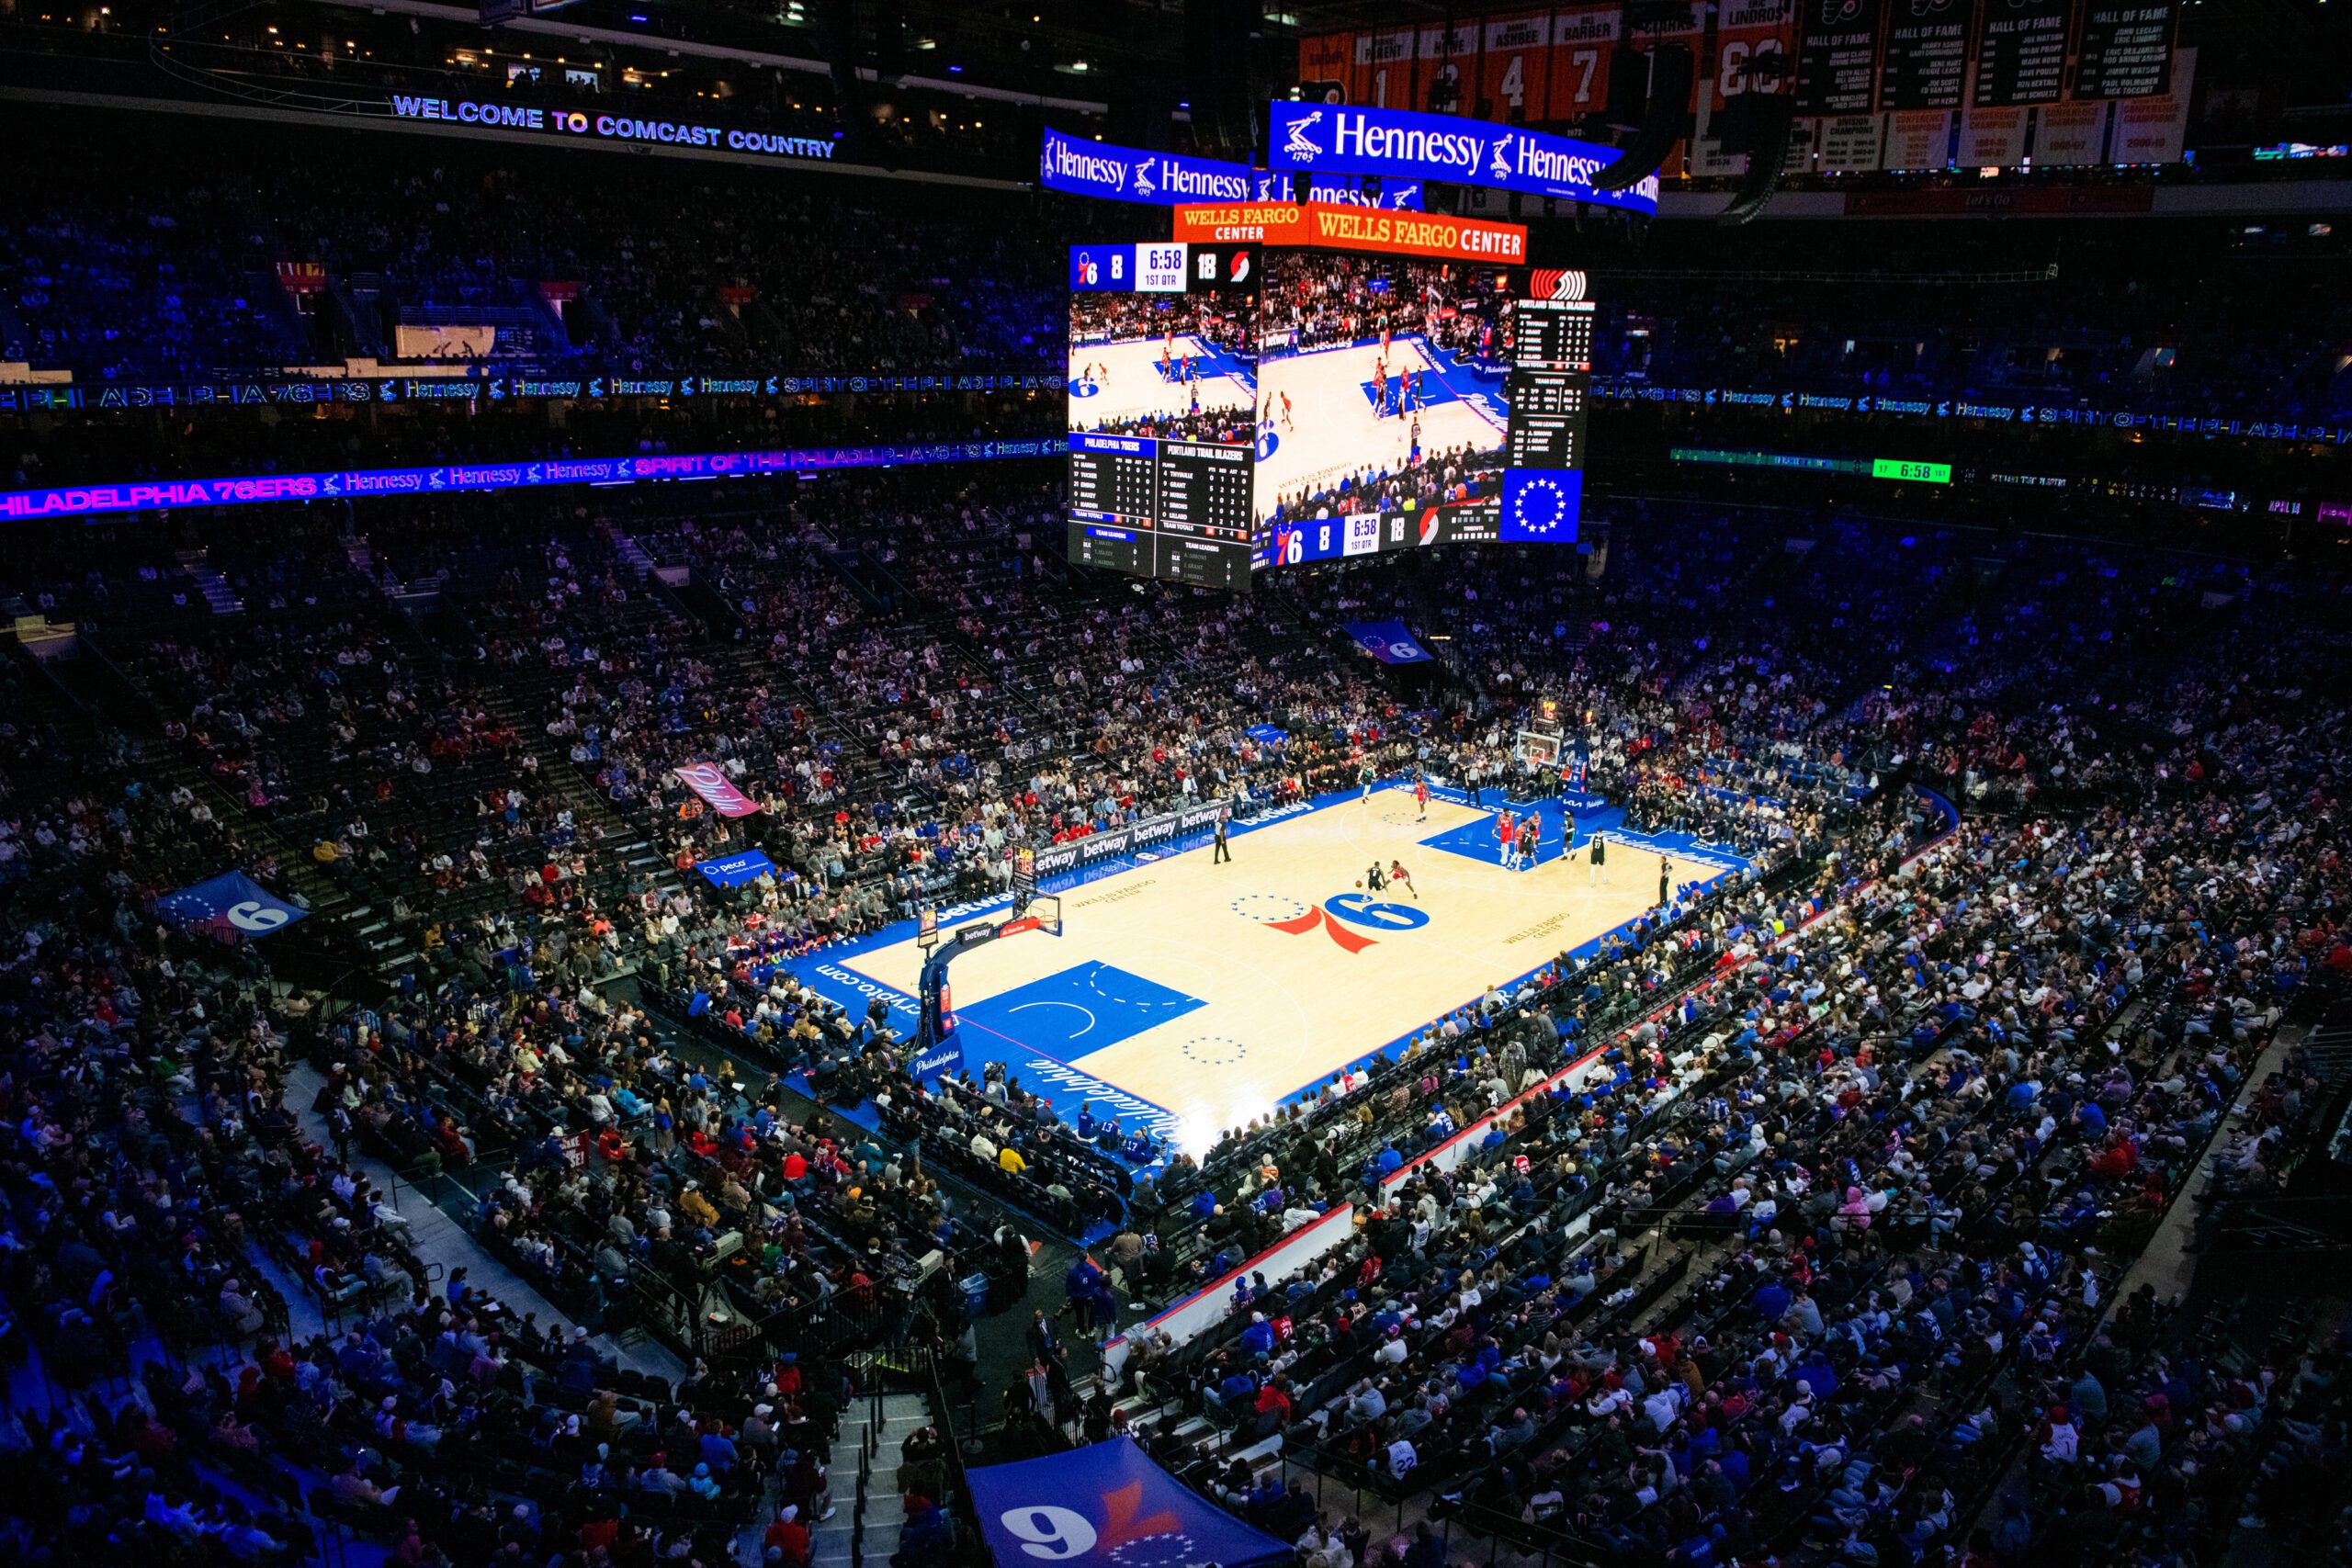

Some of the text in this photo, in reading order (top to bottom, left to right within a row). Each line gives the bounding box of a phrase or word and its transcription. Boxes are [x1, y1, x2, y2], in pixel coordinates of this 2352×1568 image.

[1728, 8, 1783, 25] LINDROS
[2093, 6, 2169, 23] HALL OF FAME
[1565, 24, 1611, 40] BARBER
[1894, 24, 1963, 39] HALL OF FAME
[1989, 16, 2063, 34] HALL OF FAME
[1496, 30, 1538, 47] ASHBEE
[1806, 32, 1871, 47] HALL OF FAME
[1500, 55, 1525, 107] 4
[1573, 49, 1599, 104] 7
[1969, 110, 2022, 121] CONFERENCE
[393, 96, 834, 158] WELCOME TO COMCAST COUNTRY
[1829, 126, 1874, 136] CHAMPIONS
[1291, 151, 1315, 163] 1765
[1335, 113, 1485, 176] Hennessy
[1057, 140, 1250, 203] Hennessy Hennessy
[1965, 194, 2011, 206] Let's Go
[1184, 208, 1299, 226] WELLS FARGO
[1215, 226, 1264, 240] CENTER
[1317, 211, 1522, 256] WELLS FARGO CENTER
[1111, 254, 1124, 279] 8
[1149, 249, 1182, 270] 6:58
[1197, 253, 1216, 279] 18
[1146, 274, 1177, 286] 1ST QTR
[1519, 299, 1547, 309] PORTLAND
[1548, 301, 1565, 310] TRAIL
[405, 379, 481, 400] Hennessy
[512, 378, 582, 398] Hennessy
[610, 376, 673, 397] Hennessy
[700, 376, 760, 396] Hennessy
[1722, 389, 2015, 422] Hennessy Hennessy Hennessy Hennessy
[1085, 438, 1139, 452] PHILADELPHIA 76ERS
[1168, 445, 1243, 461] PORTLAND TRAIL BLAZERS
[213, 477, 318, 501] 76ERS
[345, 471, 423, 492] Hennessy
[449, 467, 521, 486] Hennessy
[545, 460, 612, 480] Hennessy
[635, 456, 703, 475] SPIRIT
[710, 455, 738, 471] OF
[744, 452, 786, 468] THE
[996, 441, 1039, 456] Hennessy
[1900, 464, 1930, 479] 6:58
[1095, 529, 1126, 539] TEAM LEADERS
[1354, 518, 1377, 537] 6:58
[1390, 516, 1405, 542] 18
[1185, 542, 1219, 552] TEAM LEADERS
[1318, 525, 1330, 552] 8
[1351, 540, 1372, 550] 1ST QTR
[1389, 642, 1419, 659] 6
[1544, 709, 1555, 719] 16
[1182, 807, 1222, 829] betway
[1134, 818, 1176, 842] betway
[1083, 834, 1128, 858] betway
[719, 860, 746, 873] peco
[1035, 850, 1077, 872] etway
[1104, 889, 1141, 904] CENTER
[965, 927, 991, 941] betway
[1532, 923, 1564, 940] CENTER
[1652, 974, 1658, 984] 6
[815, 964, 921, 1015] crypto.com
[916, 1050, 959, 1075] Philadelphia
[1101, 1122, 1114, 1133] 13
[1126, 1140, 1138, 1152] 17
[2064, 1441, 2071, 1455] 1
[1396, 1457, 1415, 1473] 22
